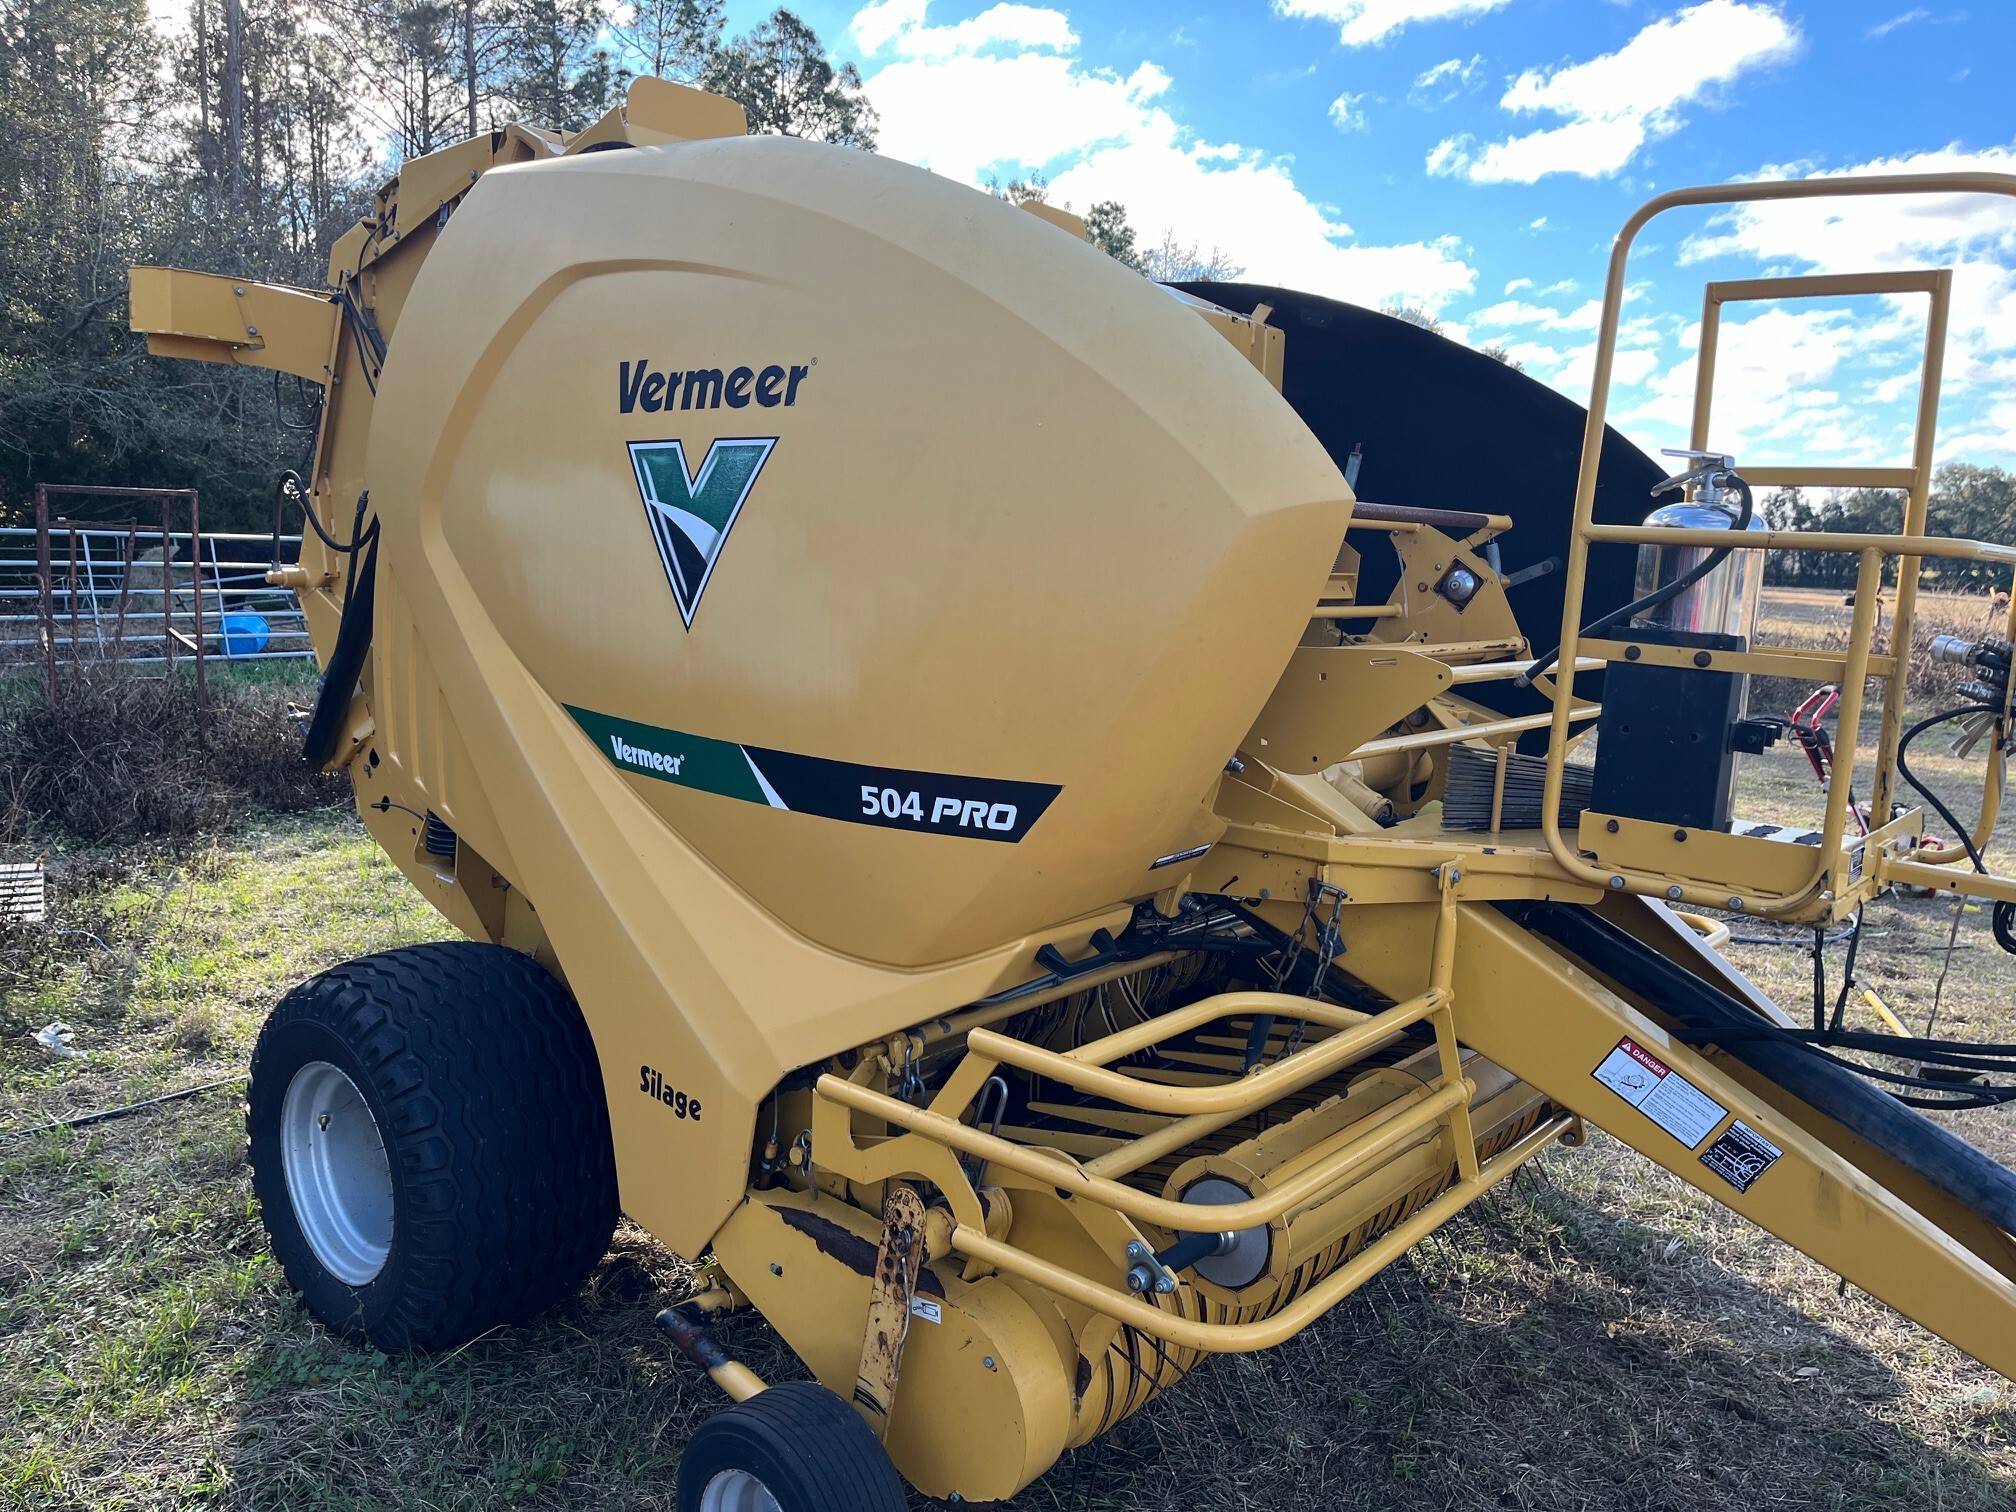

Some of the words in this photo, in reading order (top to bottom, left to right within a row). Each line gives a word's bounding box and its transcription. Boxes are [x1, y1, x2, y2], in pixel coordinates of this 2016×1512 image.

[861, 784, 925, 822] 504
[930, 796, 1018, 832] PRO
[1632, 1048, 1667, 1077] DANGER
[640, 1065, 702, 1122] Silage
[1743, 1127, 1773, 1149] IMPORTANT
